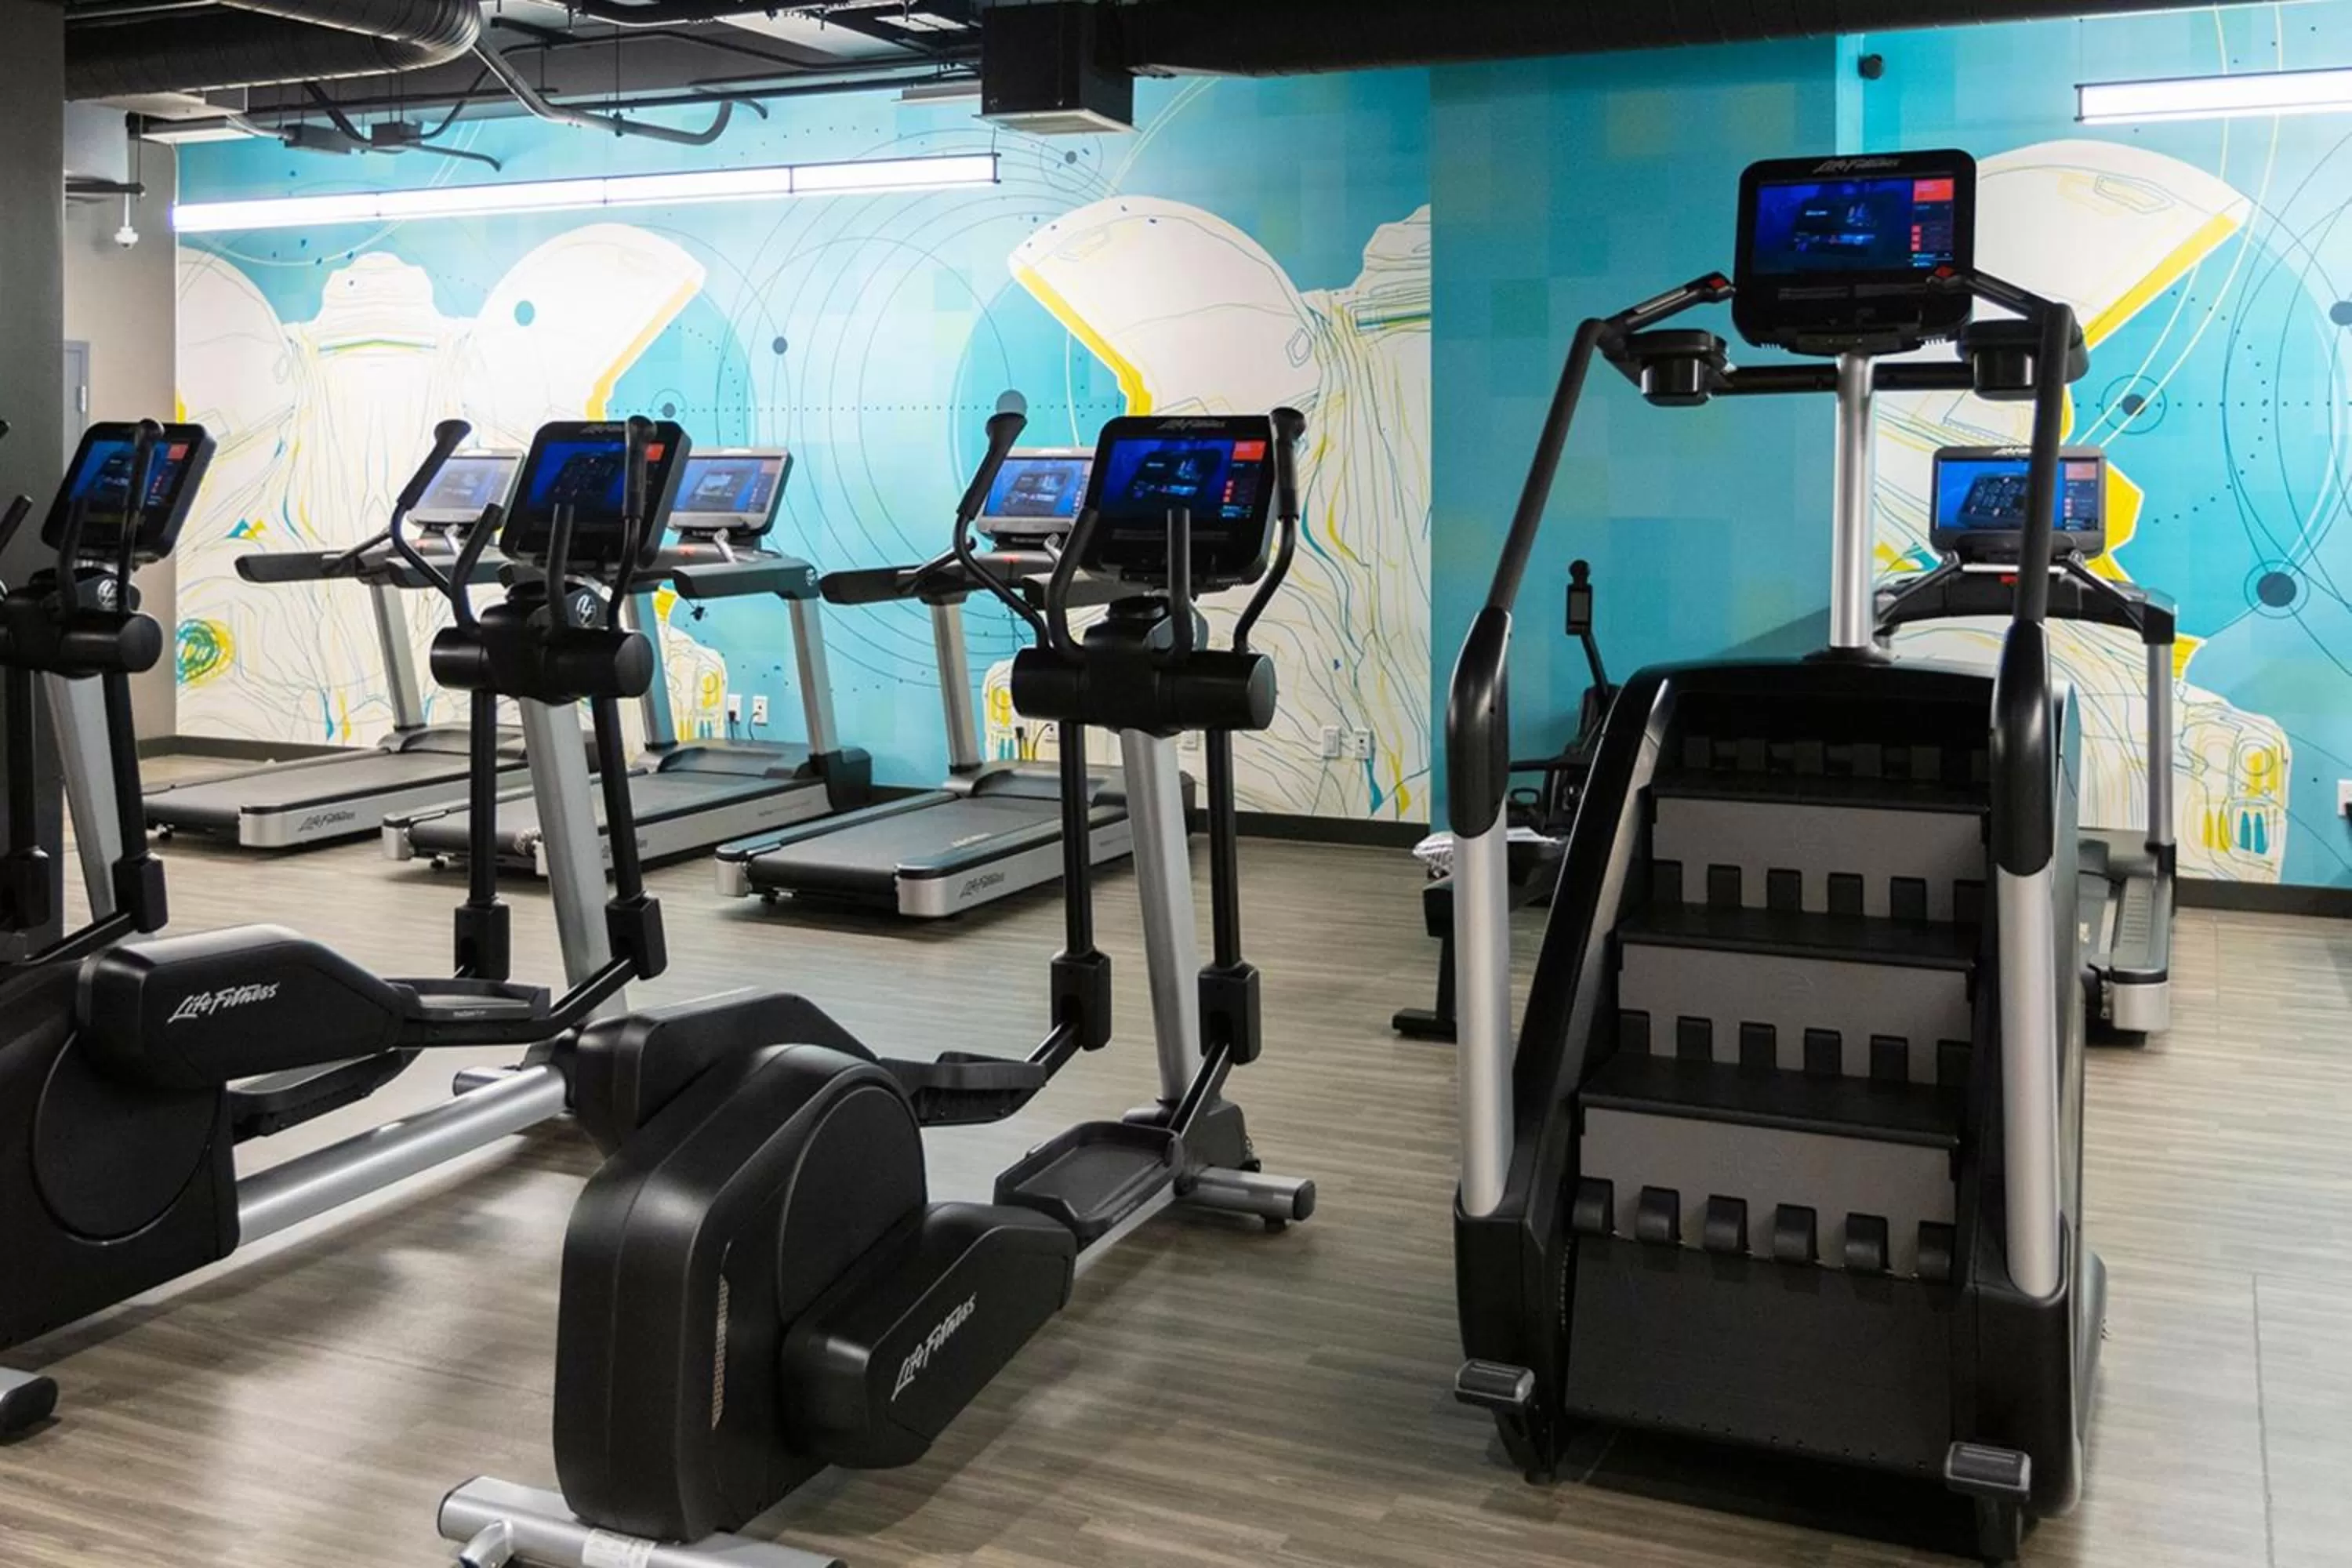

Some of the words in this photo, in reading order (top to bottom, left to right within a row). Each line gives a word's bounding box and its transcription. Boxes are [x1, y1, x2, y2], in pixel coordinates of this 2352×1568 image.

[167, 991, 212, 1024] Life
[208, 982, 281, 1015] Fitness
[891, 1343, 924, 1402] Life
[922, 1292, 977, 1368] Fitness
